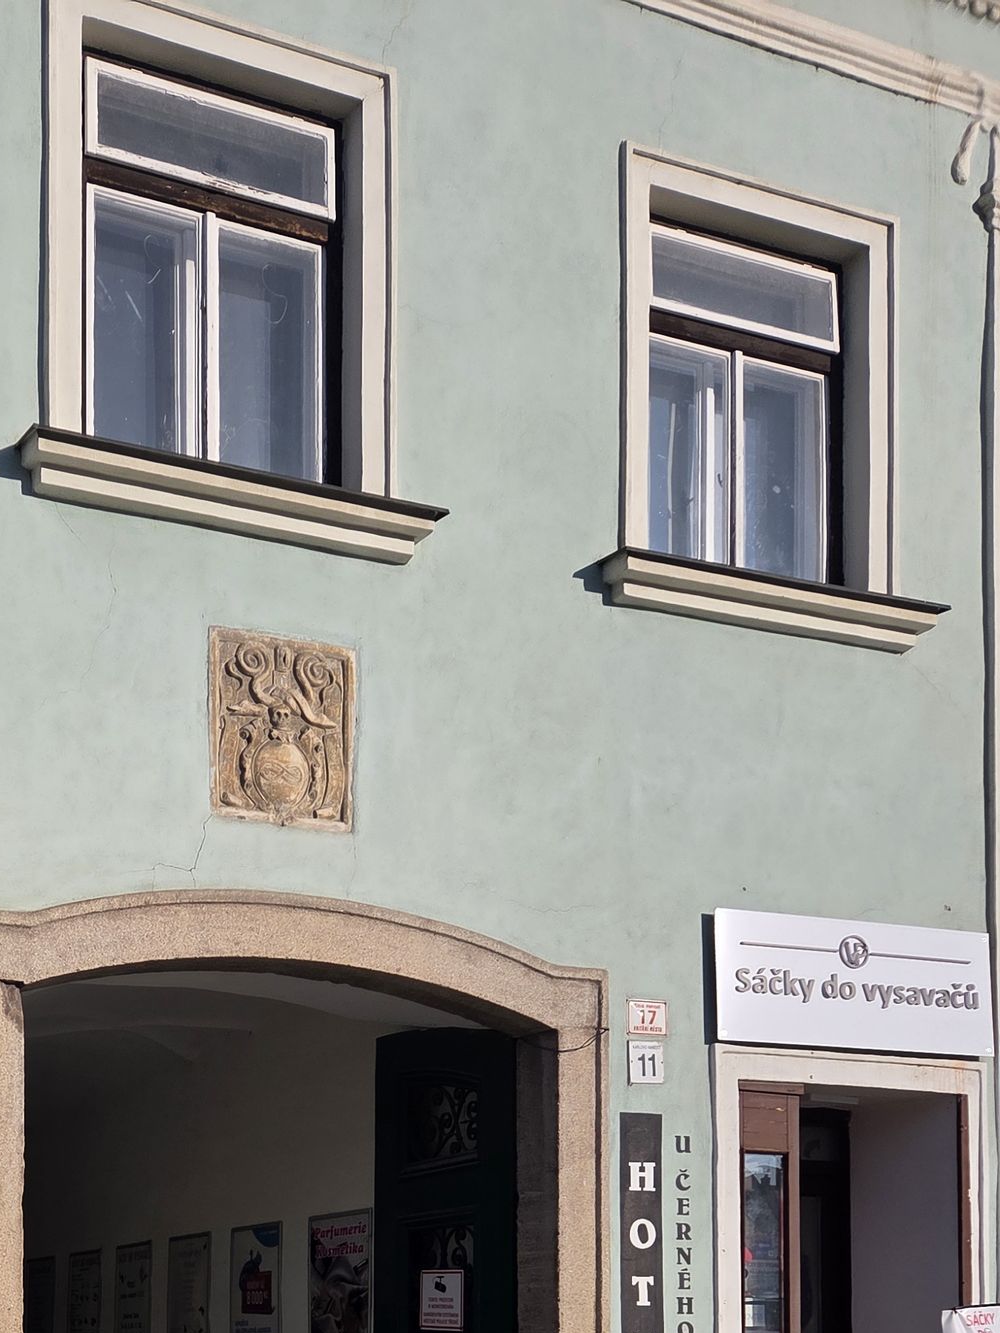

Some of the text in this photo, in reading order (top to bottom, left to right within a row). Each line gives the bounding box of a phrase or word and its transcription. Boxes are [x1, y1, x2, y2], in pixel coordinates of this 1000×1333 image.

[735, 967, 980, 1010] Sáčky do vysavačů
[640, 1010, 656, 1024] 17
[638, 1054, 656, 1076] 11
[314, 1221, 366, 1239] Parfumerie
[315, 1241, 364, 1258] Kosmetika
[966, 1311, 994, 1326] SÁČKY
